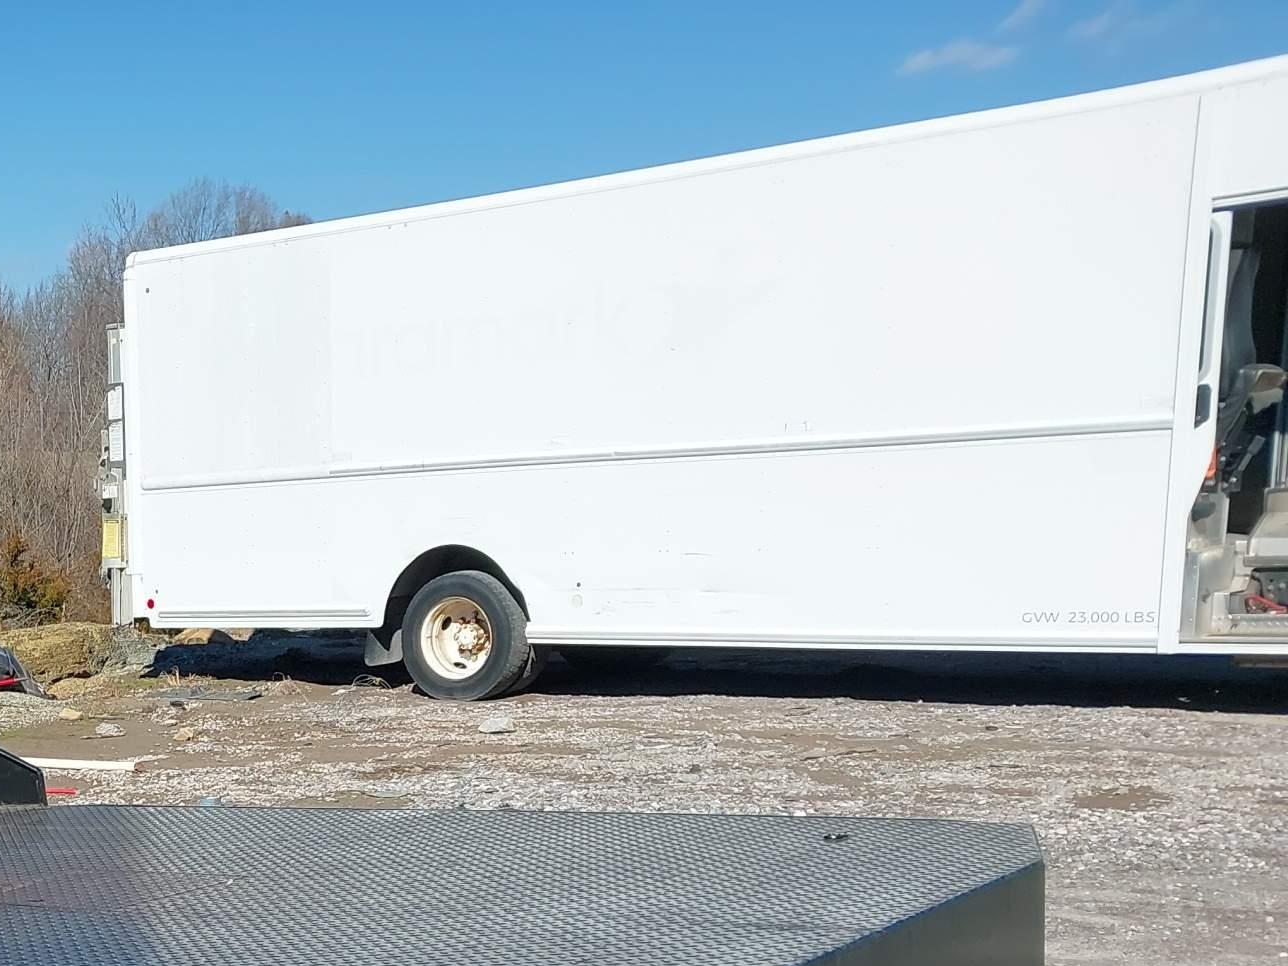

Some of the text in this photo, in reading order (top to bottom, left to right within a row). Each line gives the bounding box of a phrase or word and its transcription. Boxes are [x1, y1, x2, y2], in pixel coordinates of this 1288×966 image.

[1021, 611, 1156, 624] GVW 23,000 LBS
